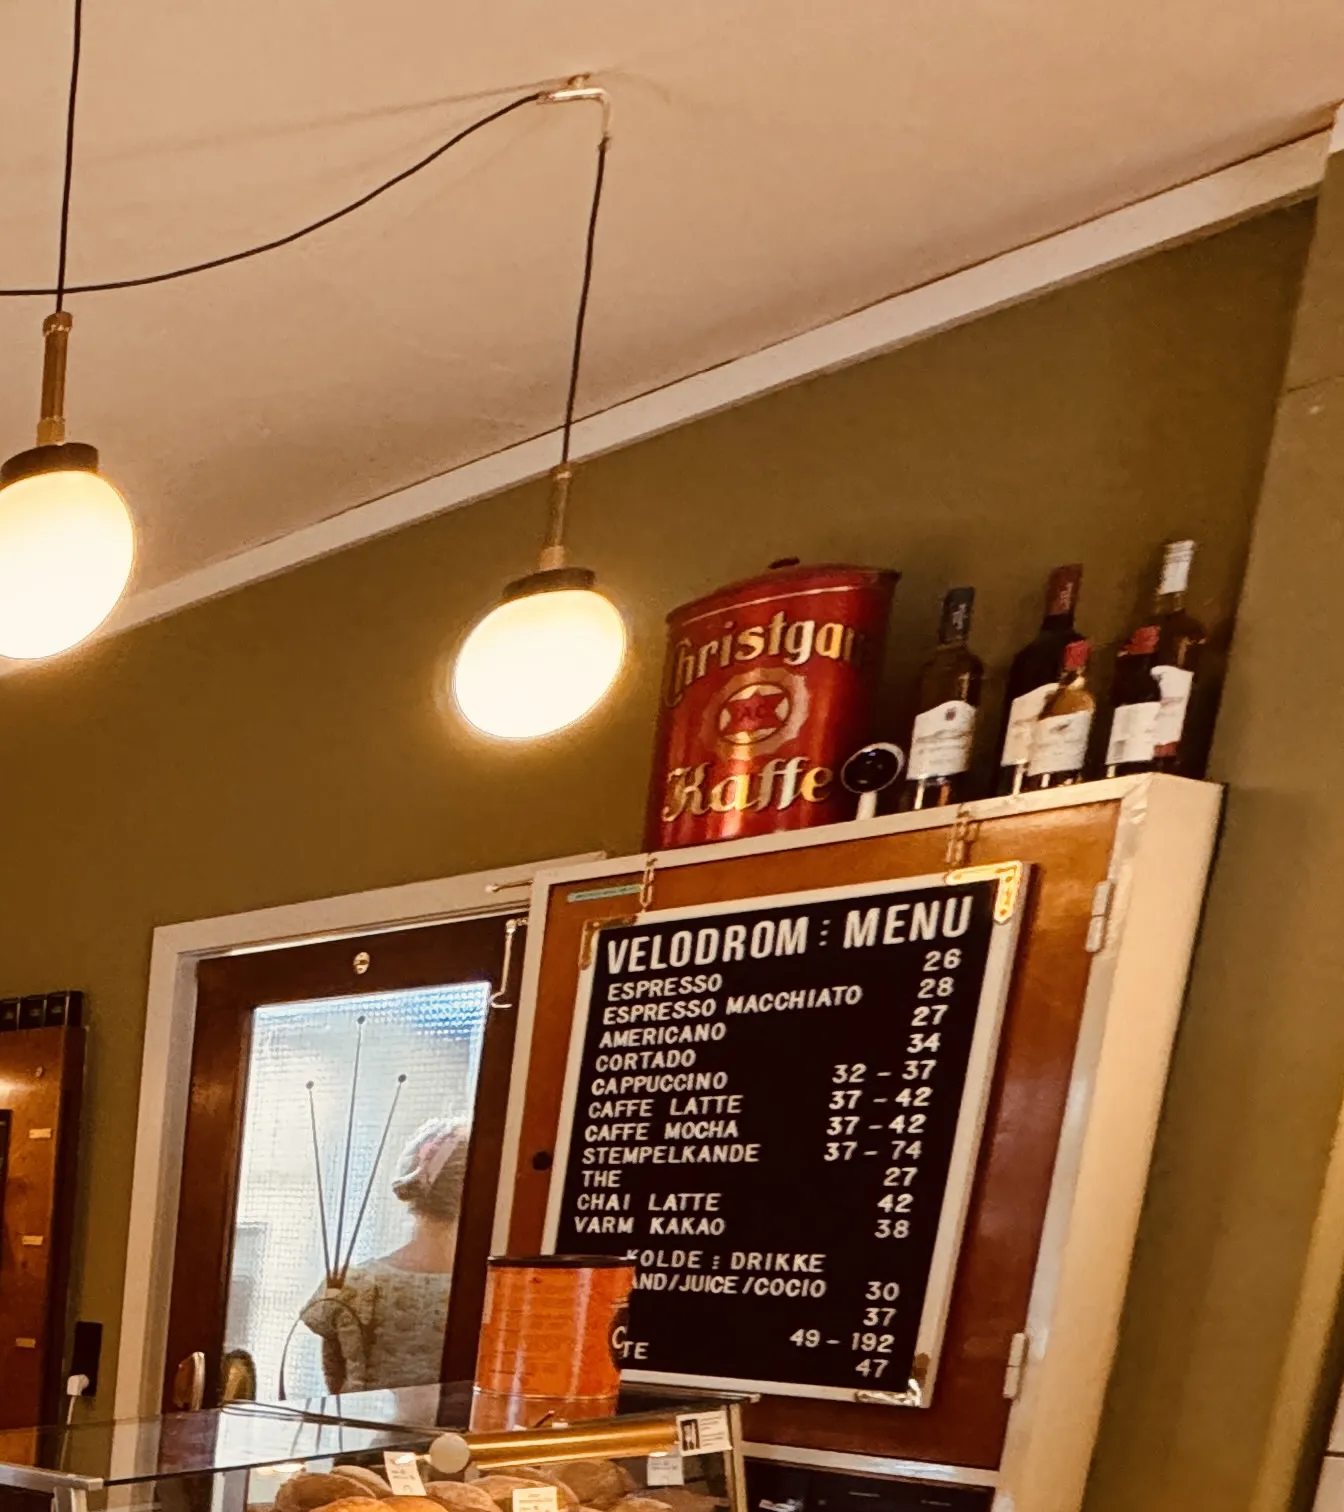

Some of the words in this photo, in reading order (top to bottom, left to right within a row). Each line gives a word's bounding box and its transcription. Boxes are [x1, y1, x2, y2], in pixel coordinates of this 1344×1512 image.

[661, 756, 835, 823] Kaffe
[607, 916, 810, 975] VELODROM
[842, 896, 974, 949] MENU
[607, 973, 723, 1002] ESPRESSO
[923, 948, 963, 972] 26
[603, 999, 716, 1025] ESPRESSO
[725, 985, 863, 1016] MACCHIATO
[917, 976, 955, 999] 28
[599, 1022, 727, 1049] AMERICANO
[911, 1005, 949, 1027] 27
[595, 1048, 697, 1072] CORTADO
[906, 1033, 942, 1054] 34
[591, 1072, 729, 1097] CAPPUCCINO
[832, 1063, 867, 1084] 32
[901, 1060, 937, 1081] 37
[588, 1099, 654, 1119] CAFFE
[669, 1094, 744, 1117] LATTE
[828, 1090, 863, 1110] 37
[894, 1086, 934, 1107] 42
[584, 1122, 649, 1142] CAFFE
[664, 1120, 739, 1141] MOCHA
[826, 1116, 861, 1136] 37
[888, 1114, 927, 1134] 42
[581, 1143, 761, 1165] STEMPELKANDE
[823, 1142, 858, 1162] 37
[890, 1140, 923, 1160] 74
[581, 1170, 623, 1188] THE
[882, 1167, 918, 1187] 27
[577, 1193, 631, 1212] CHAI
[648, 1193, 722, 1212] LATTE
[877, 1193, 913, 1213] 42
[574, 1216, 634, 1234] VARM
[649, 1217, 725, 1235] KAKAO
[874, 1219, 910, 1239] 38
[730, 1251, 826, 1272] DRIKKE
[865, 1282, 900, 1302] 30
[862, 1307, 897, 1327] 37
[789, 1328, 820, 1348] 49
[851, 1332, 895, 1354] 192
[855, 1358, 889, 1378] 47
